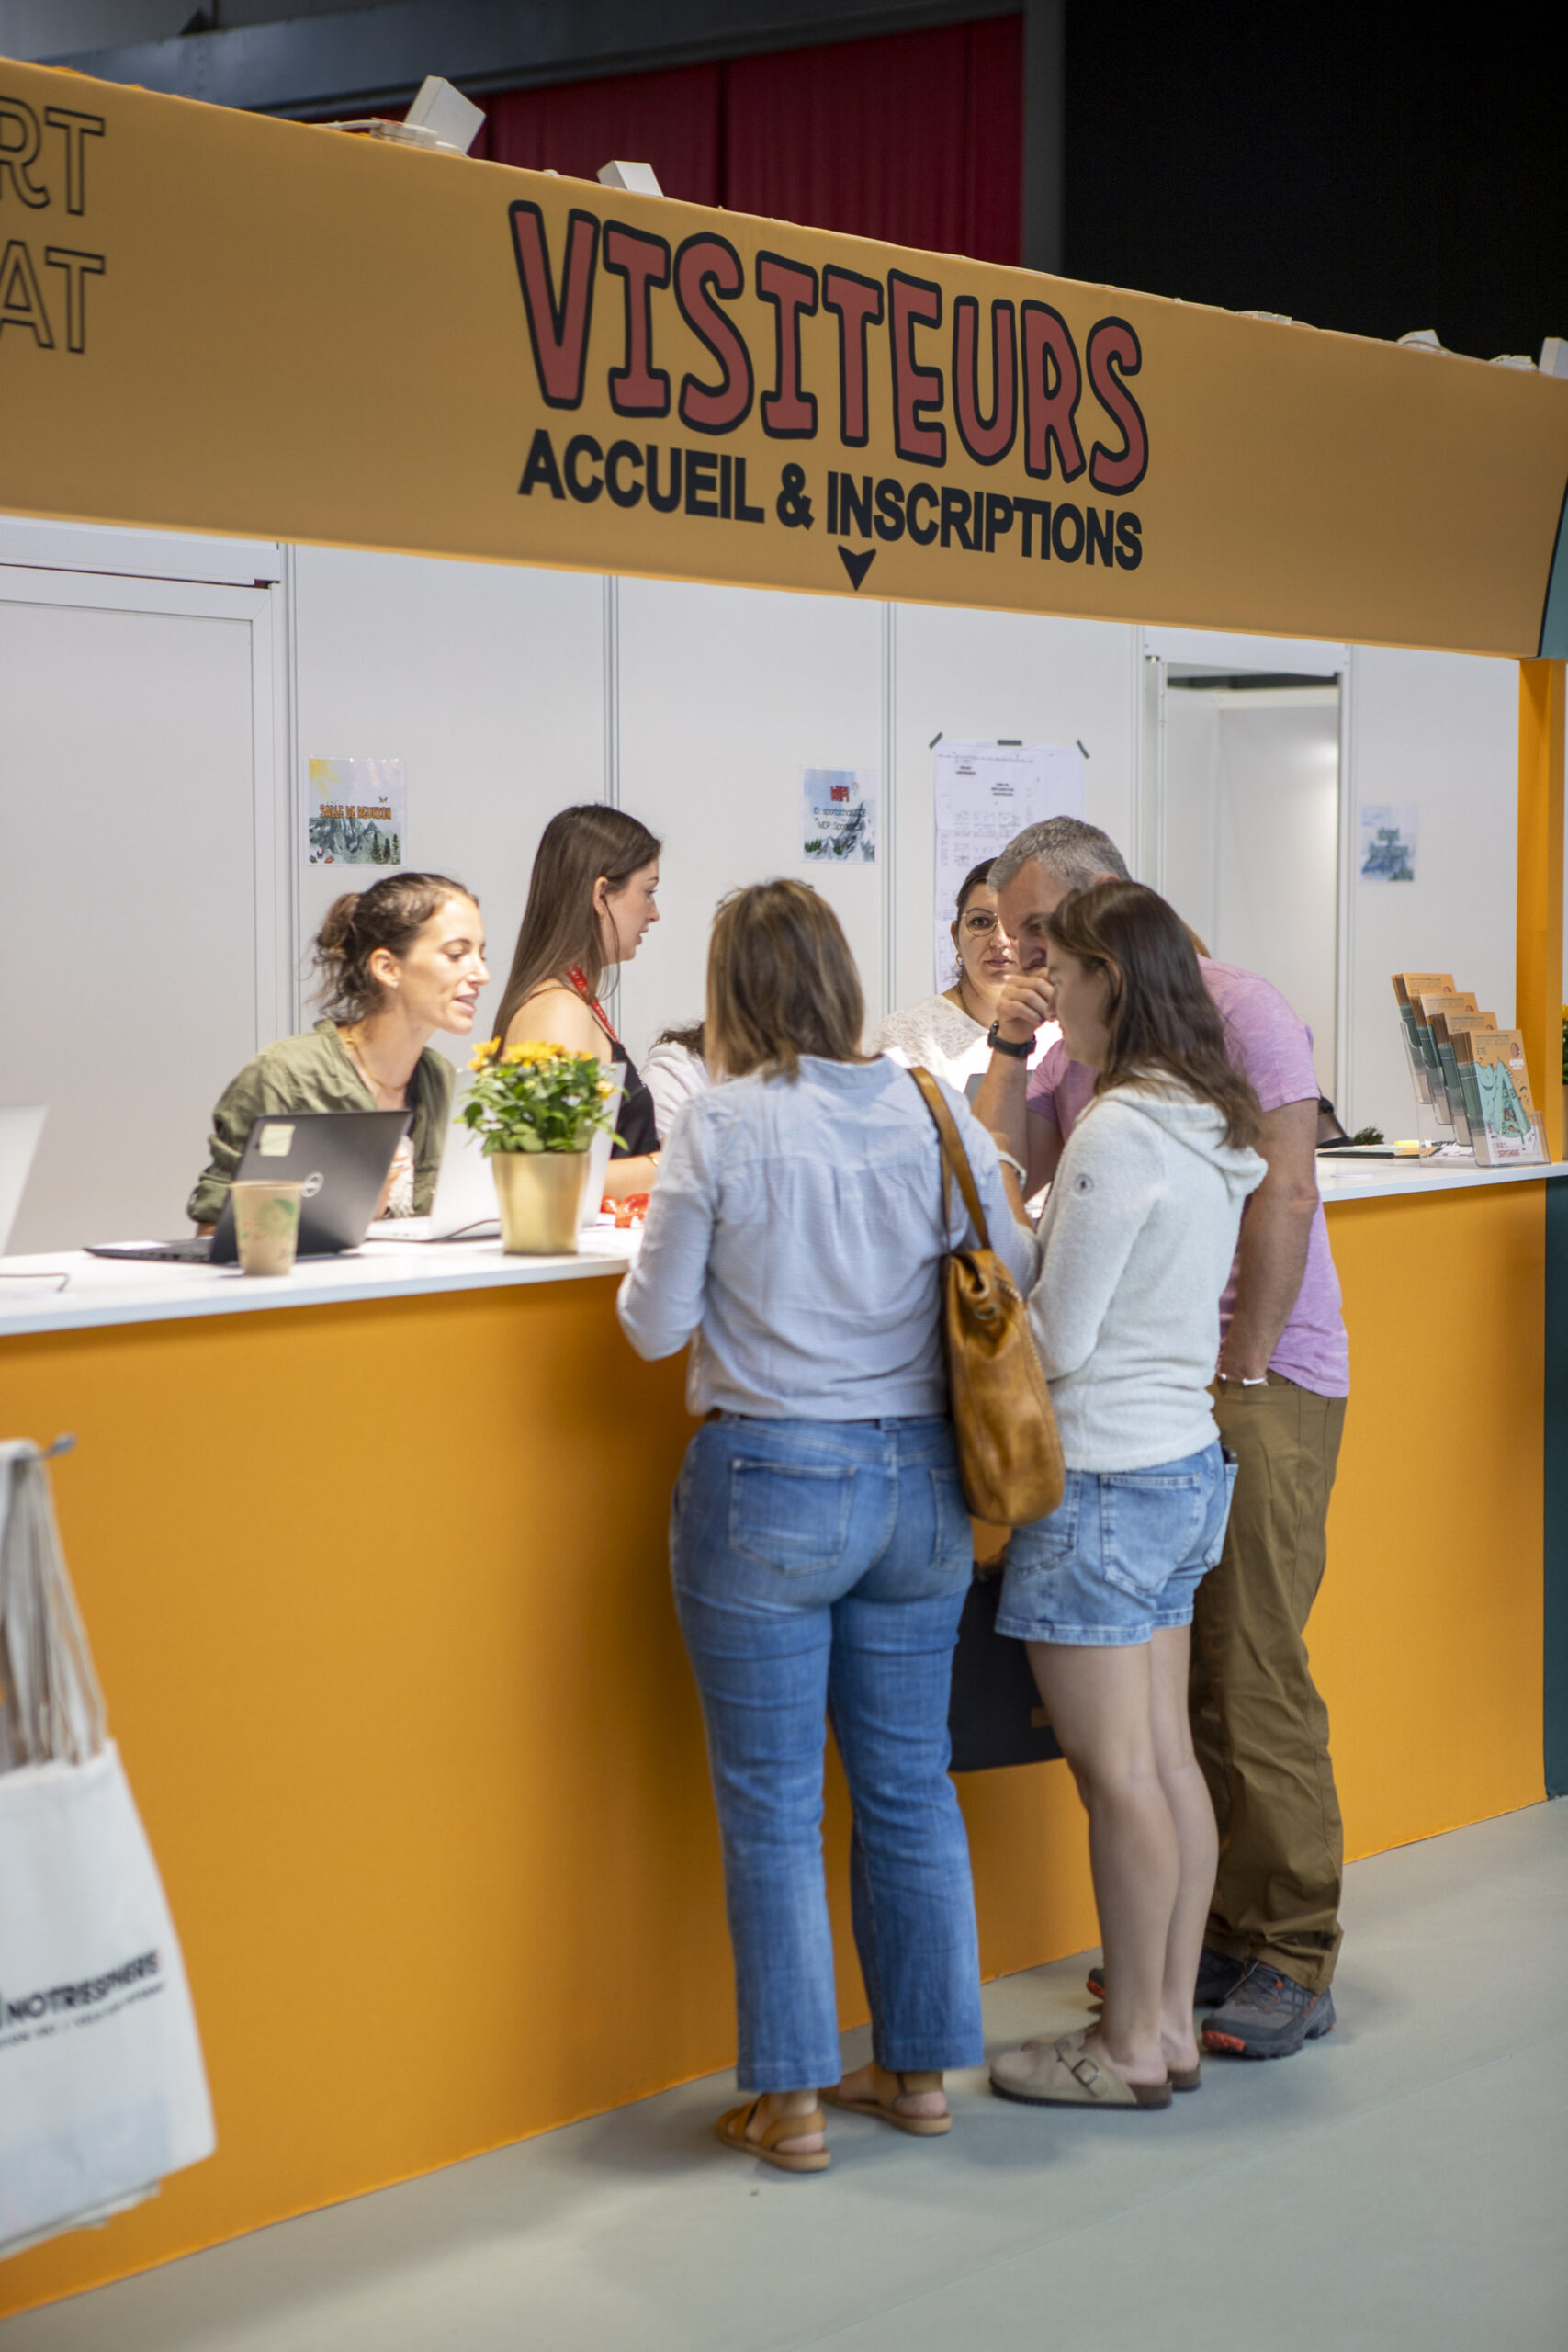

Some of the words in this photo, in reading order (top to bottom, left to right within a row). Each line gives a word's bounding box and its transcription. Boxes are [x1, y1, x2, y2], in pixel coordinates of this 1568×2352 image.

[508, 199, 1148, 496] VISITEURS
[518, 429, 764, 524] ACCUEIL
[776, 462, 814, 530] &
[827, 471, 1143, 571] INSCRIPTIONS
[319, 804, 344, 818] SALLE
[345, 805, 355, 819] DE
